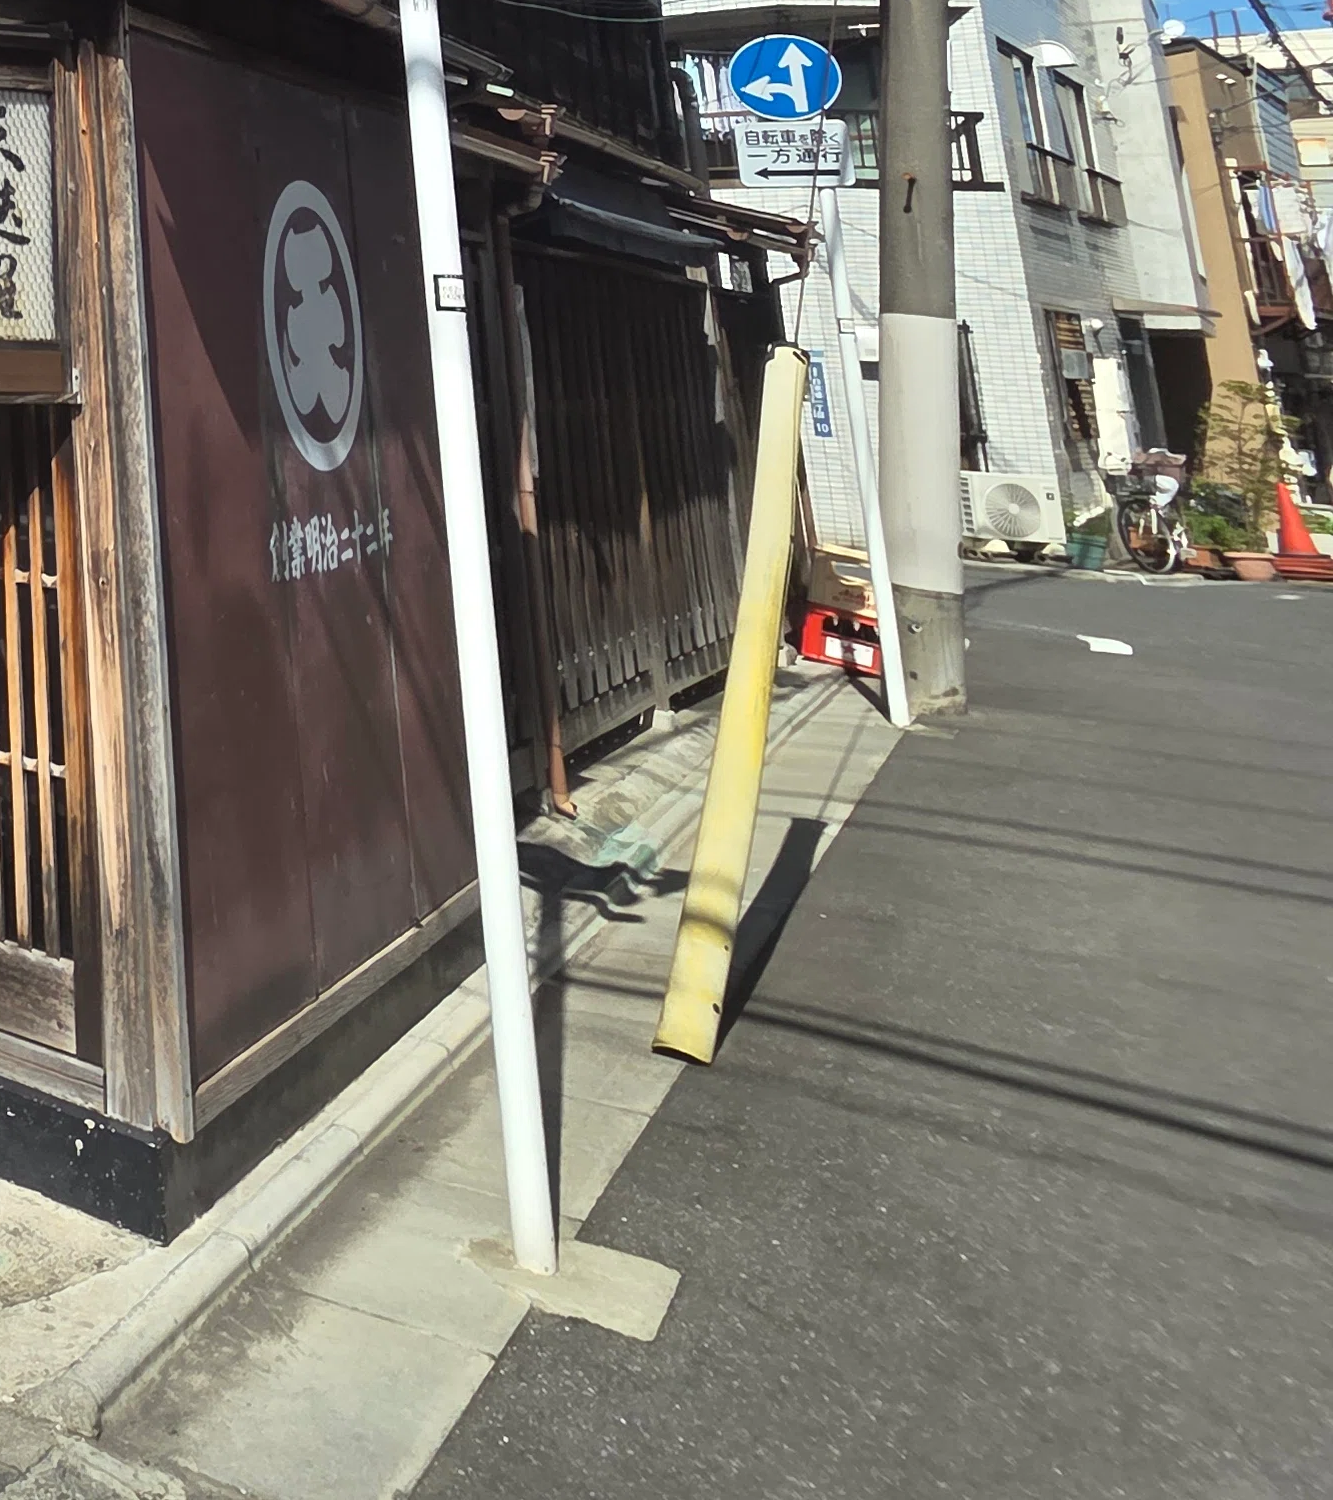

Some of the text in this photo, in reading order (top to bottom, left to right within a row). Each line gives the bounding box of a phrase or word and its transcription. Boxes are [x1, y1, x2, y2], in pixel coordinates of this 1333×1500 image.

[744, 129, 840, 146] 自転車を除く
[746, 147, 842, 164] 一方通行
[816, 422, 829, 433] 10
